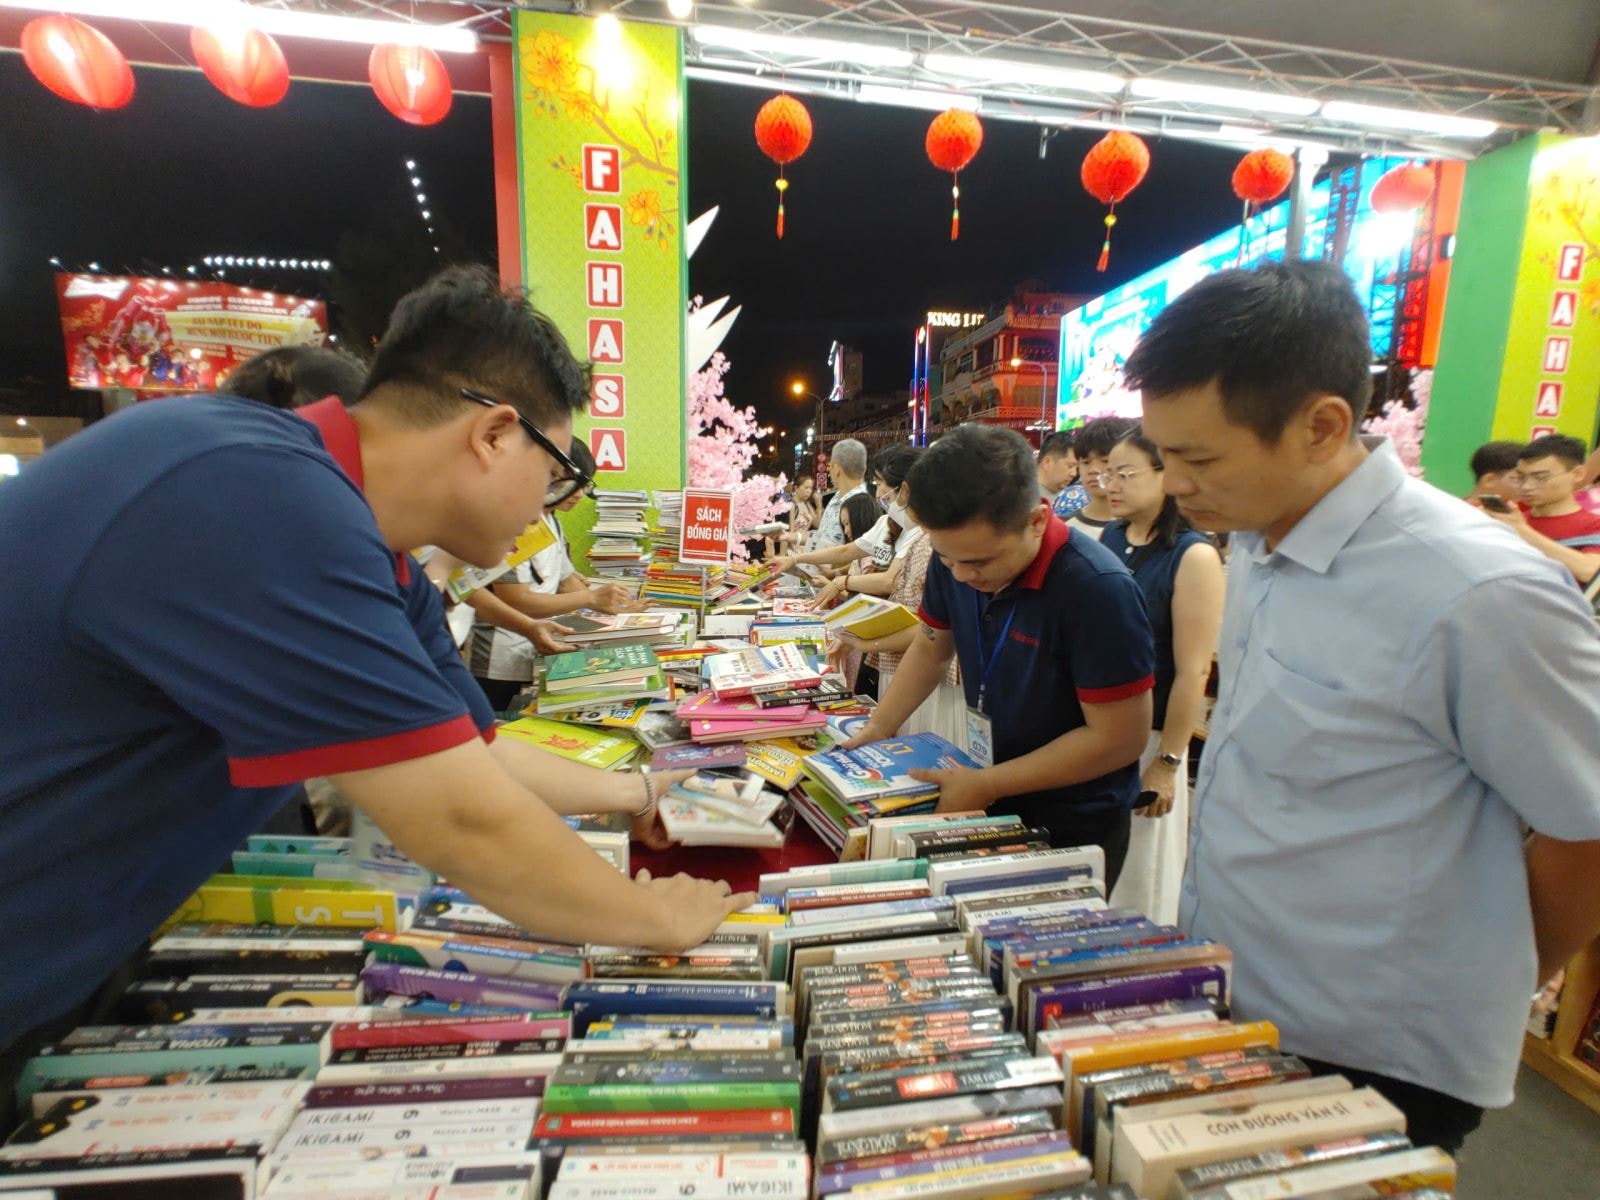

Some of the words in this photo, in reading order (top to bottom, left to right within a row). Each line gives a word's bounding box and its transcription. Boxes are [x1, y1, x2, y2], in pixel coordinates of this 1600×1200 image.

[589, 149, 624, 468] FAHASA
[696, 505, 722, 522] SÁCH
[713, 526, 728, 541] GIÁ
[169, 1039, 228, 1049] UTOPIA
[466, 1040, 499, 1048] STREAM
[308, 1111, 375, 1125] IKIGAMI
[1207, 1121, 1240, 1136] CON
[296, 1131, 364, 1146] IKIGAMI
[835, 1136, 897, 1157] KINGDOM
[727, 1181, 793, 1195] IKIGAMI
